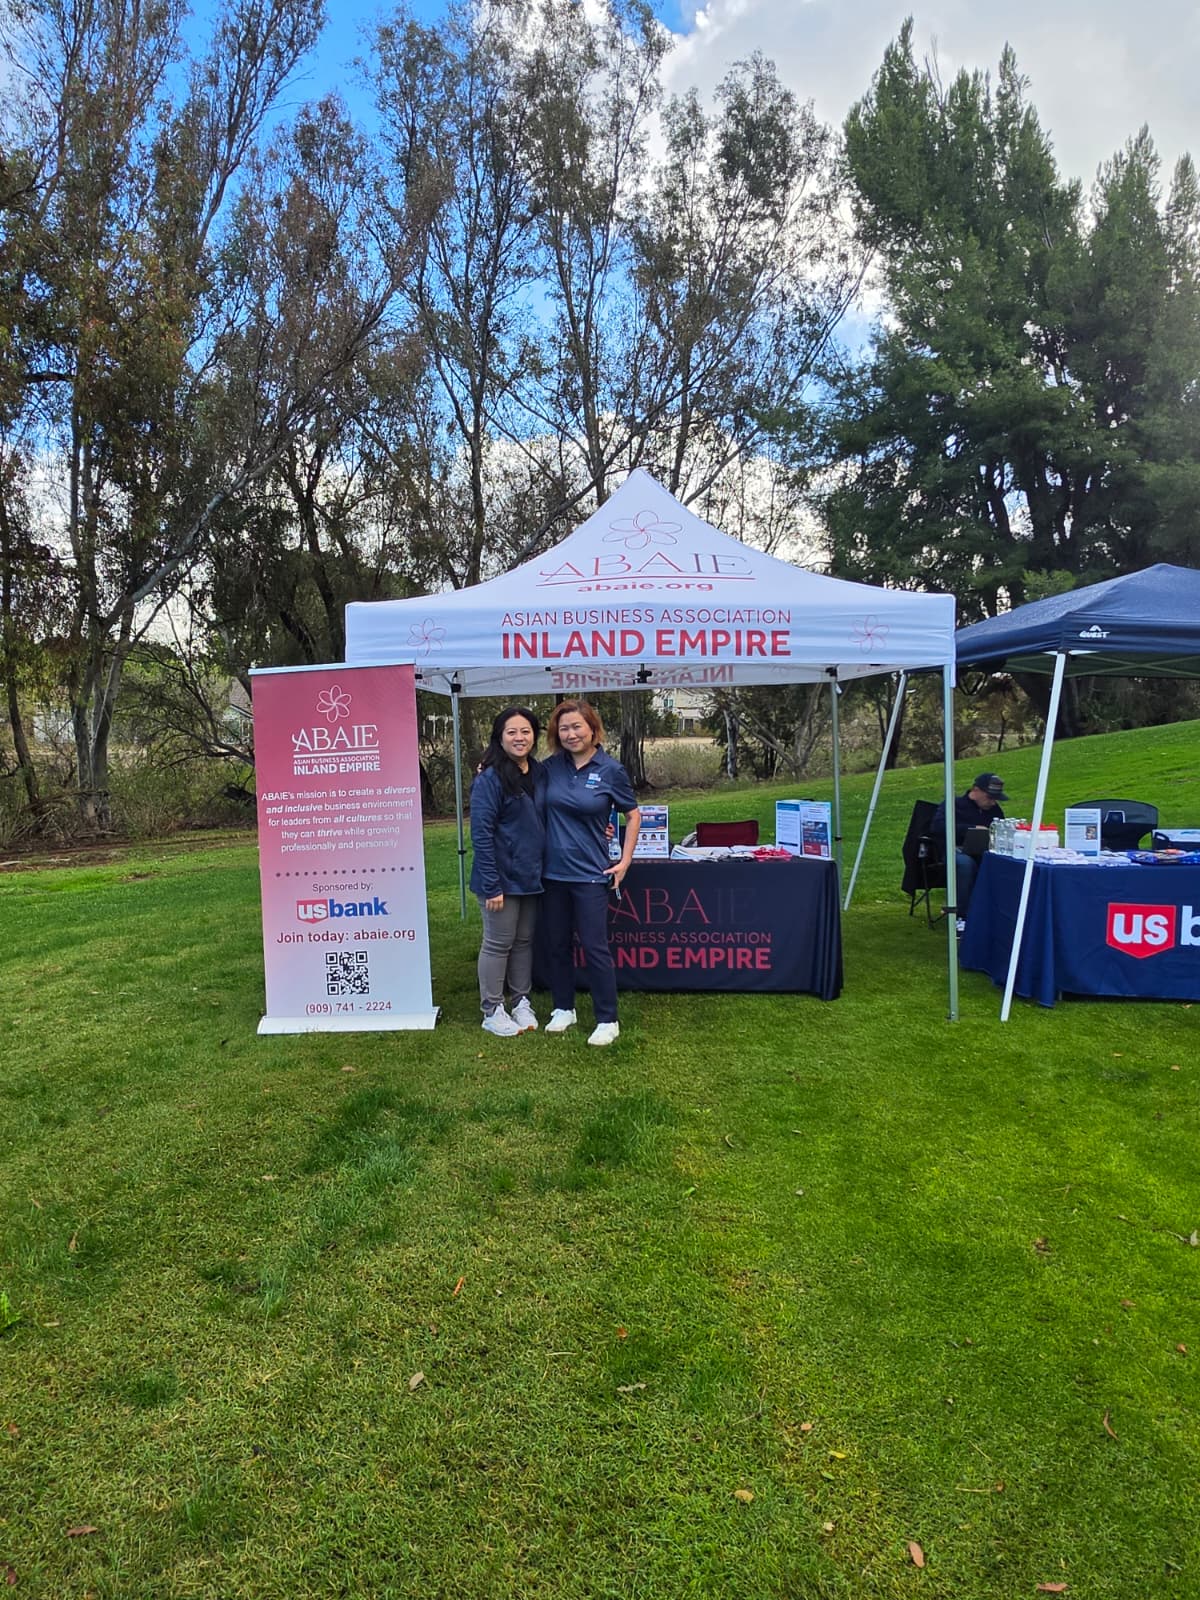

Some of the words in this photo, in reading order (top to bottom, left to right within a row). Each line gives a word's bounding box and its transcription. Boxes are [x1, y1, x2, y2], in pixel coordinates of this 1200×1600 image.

[539, 551, 753, 582] ABAIE
[577, 581, 714, 592] abaie.org
[502, 610, 557, 627] ASIAN
[563, 608, 654, 625] BUSINESS
[660, 608, 791, 624] ASSOCIATION
[502, 629, 645, 660] INLAND
[656, 629, 791, 657] EMPIRE
[291, 724, 379, 752] ABAIE
[293, 758, 311, 766] ASIAN
[341, 754, 380, 763] ASSOCIATION
[293, 763, 338, 776] INLAND
[339, 761, 381, 773] EMPIRE
[261, 791, 295, 801] ABAIE's
[296, 790, 327, 799] mission
[329, 789, 337, 797] is
[338, 789, 347, 797] to
[348, 788, 375, 796] create
[384, 786, 417, 795] diverse
[266, 805, 283, 814] and
[284, 803, 323, 813] inclusive
[324, 802, 361, 811] business
[362, 799, 414, 809] environment
[268, 818, 280, 827] for
[281, 817, 311, 826] leaders
[312, 815, 332, 824] from
[333, 814, 345, 823] all
[346, 813, 383, 823] cultures
[395, 812, 412, 820] that
[281, 830, 298, 840] they
[317, 828, 343, 837] thrive
[343, 827, 365, 836] while
[367, 826, 400, 837] growing
[281, 841, 336, 853] professionally
[338, 840, 354, 849] and
[355, 840, 398, 851] personally
[312, 882, 359, 893] Sponsored
[360, 882, 374, 892] by:
[276, 932, 304, 944] Join
[308, 930, 350, 944] today:
[353, 928, 416, 941] abaie.org
[608, 931, 666, 944] USINESS
[670, 932, 772, 944] ASSOCIATION
[667, 947, 772, 969] EMPIRE
[305, 1003, 333, 1016] (909)
[336, 1002, 354, 1012] 741
[366, 1001, 392, 1011] 2224
